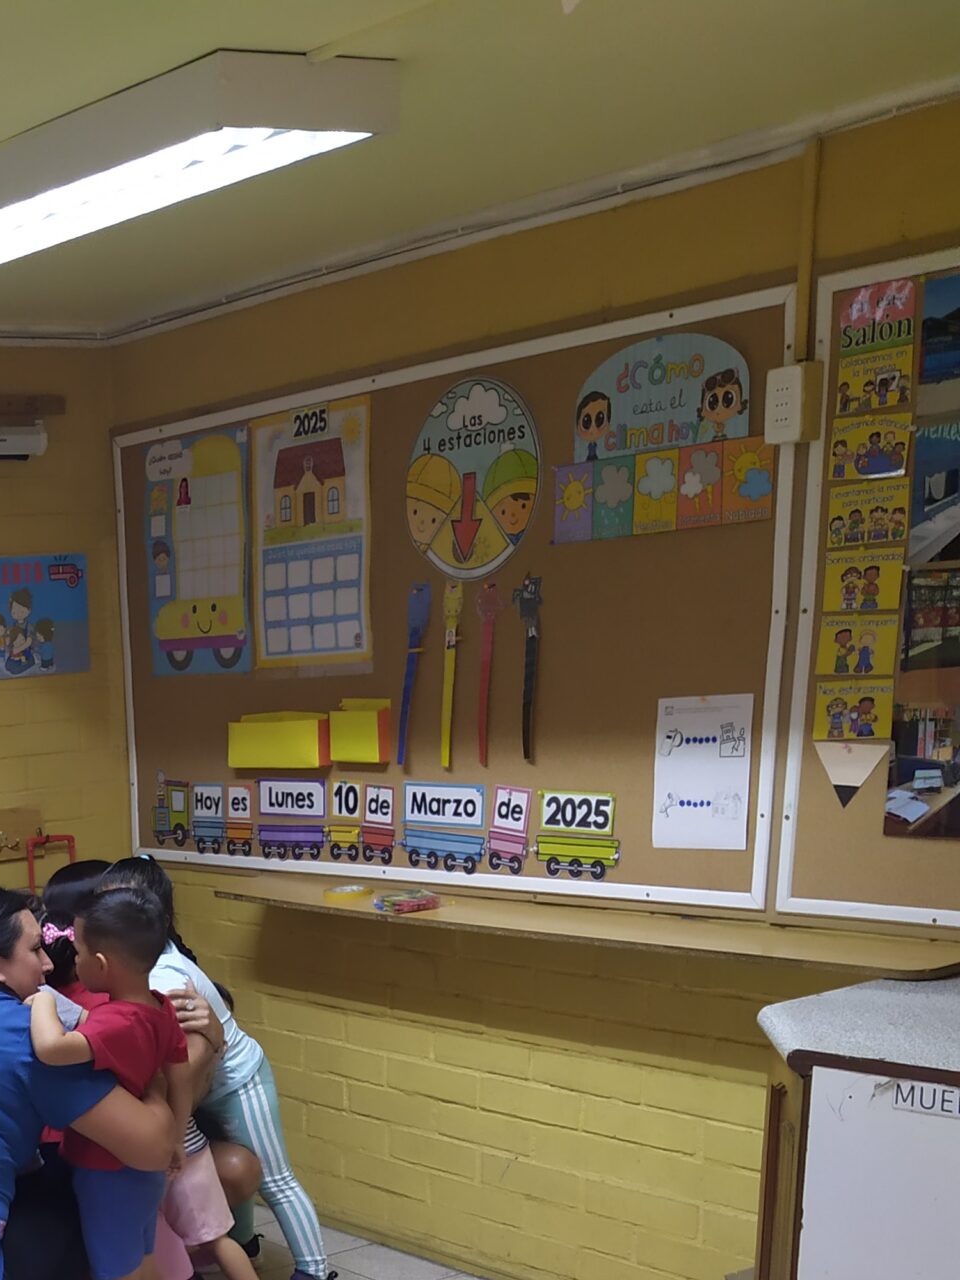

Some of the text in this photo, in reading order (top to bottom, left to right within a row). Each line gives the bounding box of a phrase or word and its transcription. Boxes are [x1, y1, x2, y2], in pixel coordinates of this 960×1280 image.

[841, 313, 912, 349] Salón
[615, 353, 705, 394] ¿Cómo
[670, 388, 687, 410] el
[293, 409, 327, 438] 2025
[462, 414, 483, 429] Las
[603, 421, 665, 451] clima
[423, 424, 526, 454] 4 estaciones
[195, 785, 611, 830] Hoy es Lunes 10 de Marzo de 2025
[895, 1083, 960, 1114] MUE
